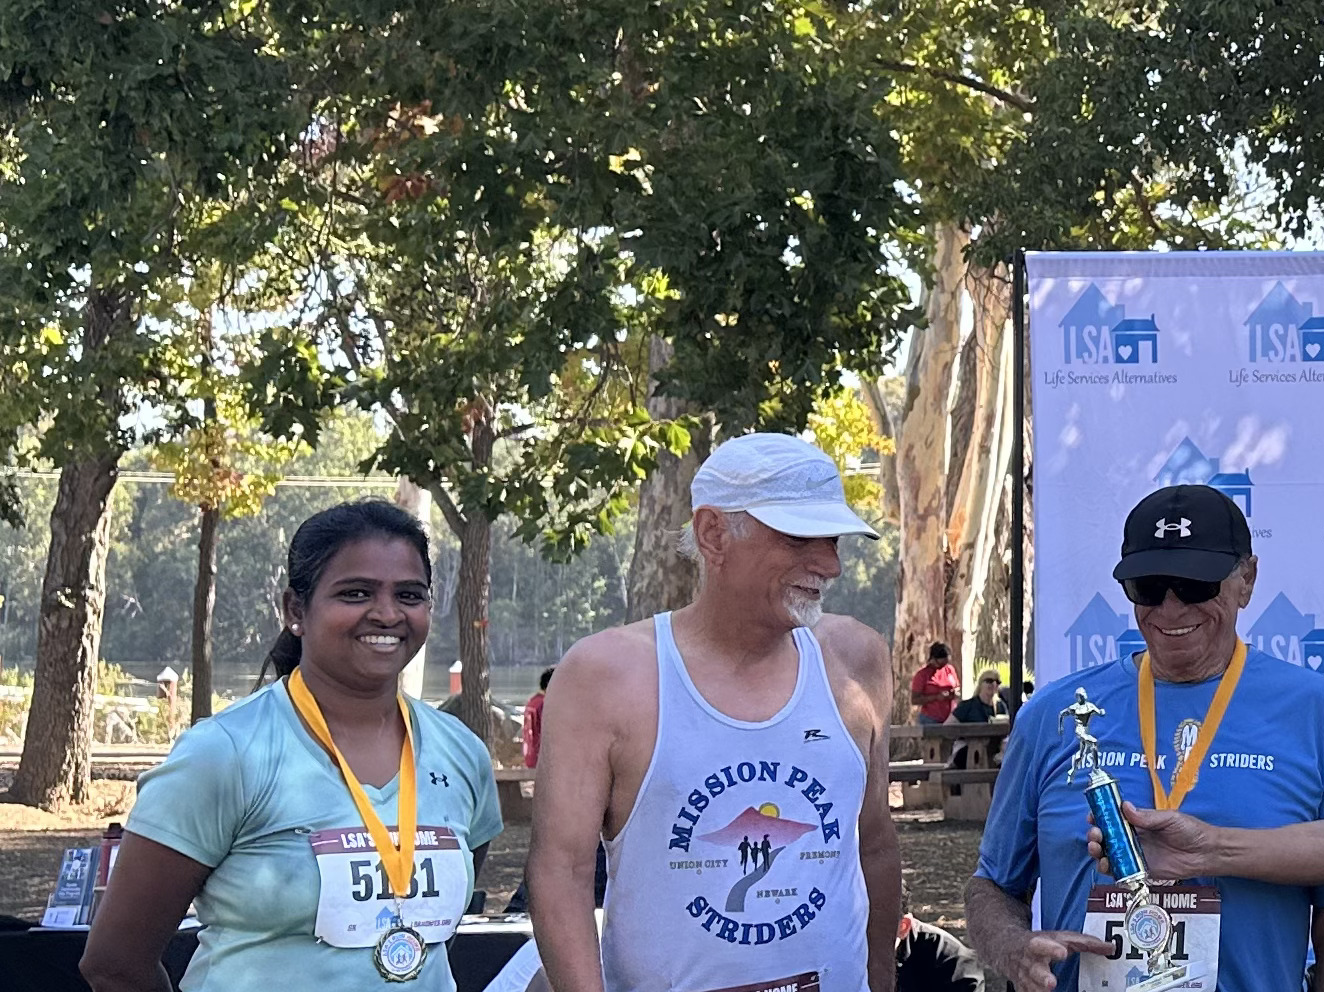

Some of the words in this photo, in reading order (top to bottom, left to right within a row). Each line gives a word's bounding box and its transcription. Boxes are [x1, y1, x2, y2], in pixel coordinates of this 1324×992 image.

[1070, 325, 1115, 364] LSA
[1256, 323, 1300, 363] LSA
[1044, 371, 1065, 388] Life
[1067, 371, 1109, 385] Services
[1111, 368, 1177, 384] Alternatives
[1229, 369, 1249, 387] Life
[1252, 369, 1297, 383] Services
[1073, 752, 1126, 770] ISSION
[1130, 753, 1167, 770] PEK
[1209, 753, 1275, 771] STRIDERS
[669, 761, 780, 852] MISSION
[784, 766, 841, 844] PEAK
[416, 831, 439, 846] OME
[670, 861, 702, 870] UNION
[705, 859, 728, 868] CITY
[756, 888, 798, 898] NEWARK
[1163, 893, 1198, 909] HOME
[686, 887, 826, 945] STRIDERS
